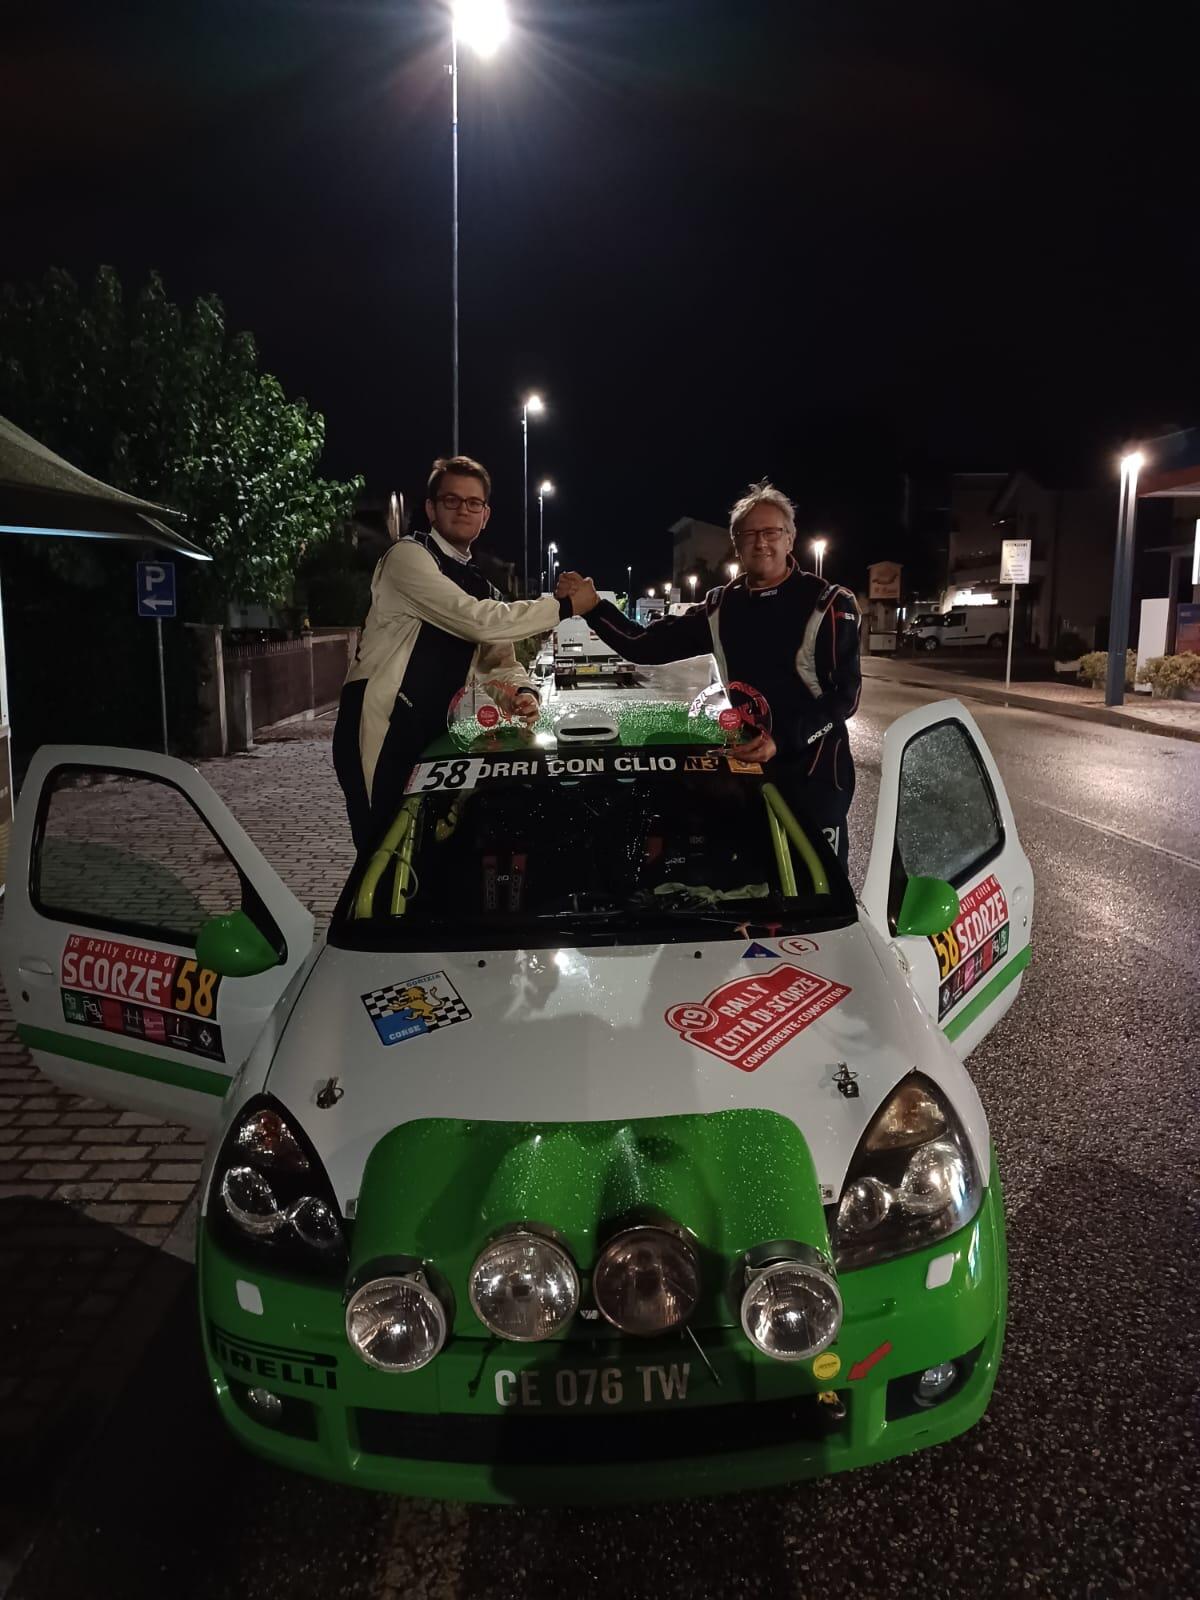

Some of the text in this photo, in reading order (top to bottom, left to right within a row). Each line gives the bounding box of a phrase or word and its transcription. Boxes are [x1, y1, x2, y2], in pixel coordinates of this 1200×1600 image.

[145, 566, 166, 591] P
[421, 761, 471, 790] 58
[549, 759, 605, 774] CON
[614, 756, 677, 772] CLIO
[87, 940, 119, 958] Rally
[125, 948, 157, 965] città
[164, 956, 177, 969] di
[63, 952, 173, 1004] SCORZE'
[175, 959, 218, 1018] 58
[714, 976, 820, 1052] CITTÀ DI SCORZÈ
[718, 982, 770, 1018] RALLY
[389, 1025, 422, 1041] CORSE
[681, 1009, 708, 1028] 19
[208, 1319, 338, 1390] PIRELLI
[494, 1362, 691, 1407] CE 076 TW
